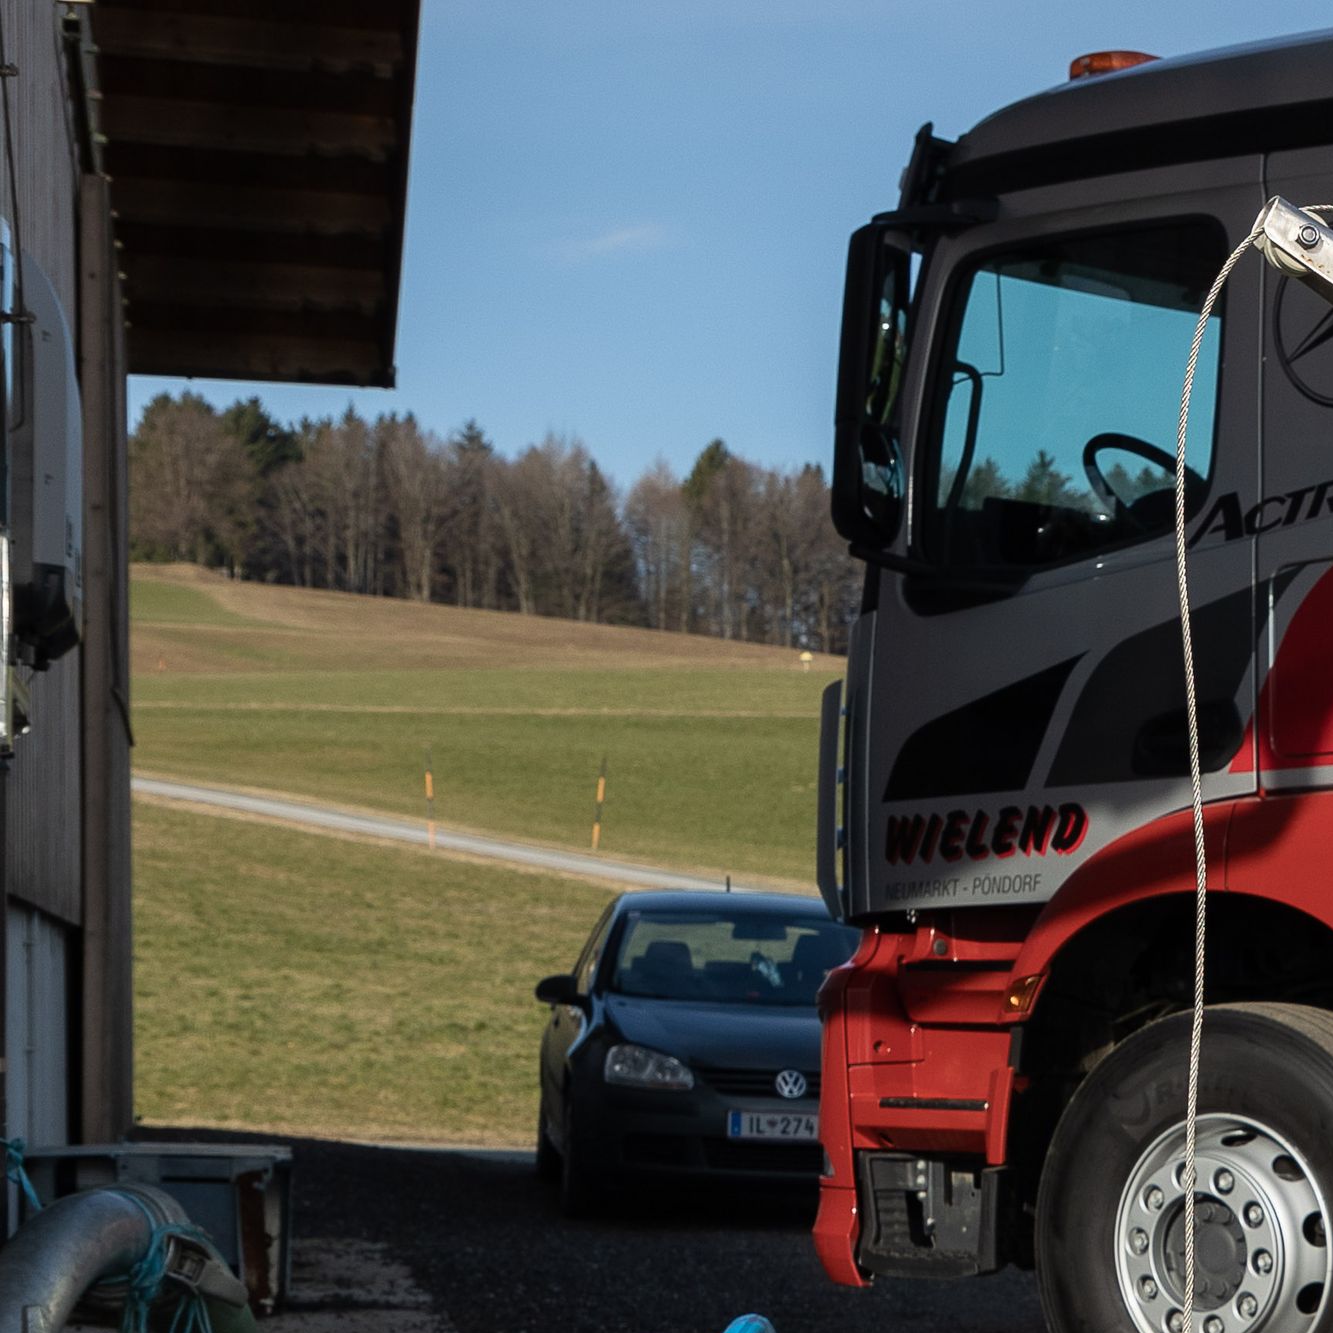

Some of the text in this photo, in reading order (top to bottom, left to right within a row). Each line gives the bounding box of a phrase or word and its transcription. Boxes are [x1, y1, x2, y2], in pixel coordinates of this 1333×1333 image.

[885, 802, 1089, 866] WIELEND
[886, 877, 960, 900] NEUMARKT
[971, 873, 1042, 895] PÖNDORF
[749, 1116, 814, 1135] IL 274
